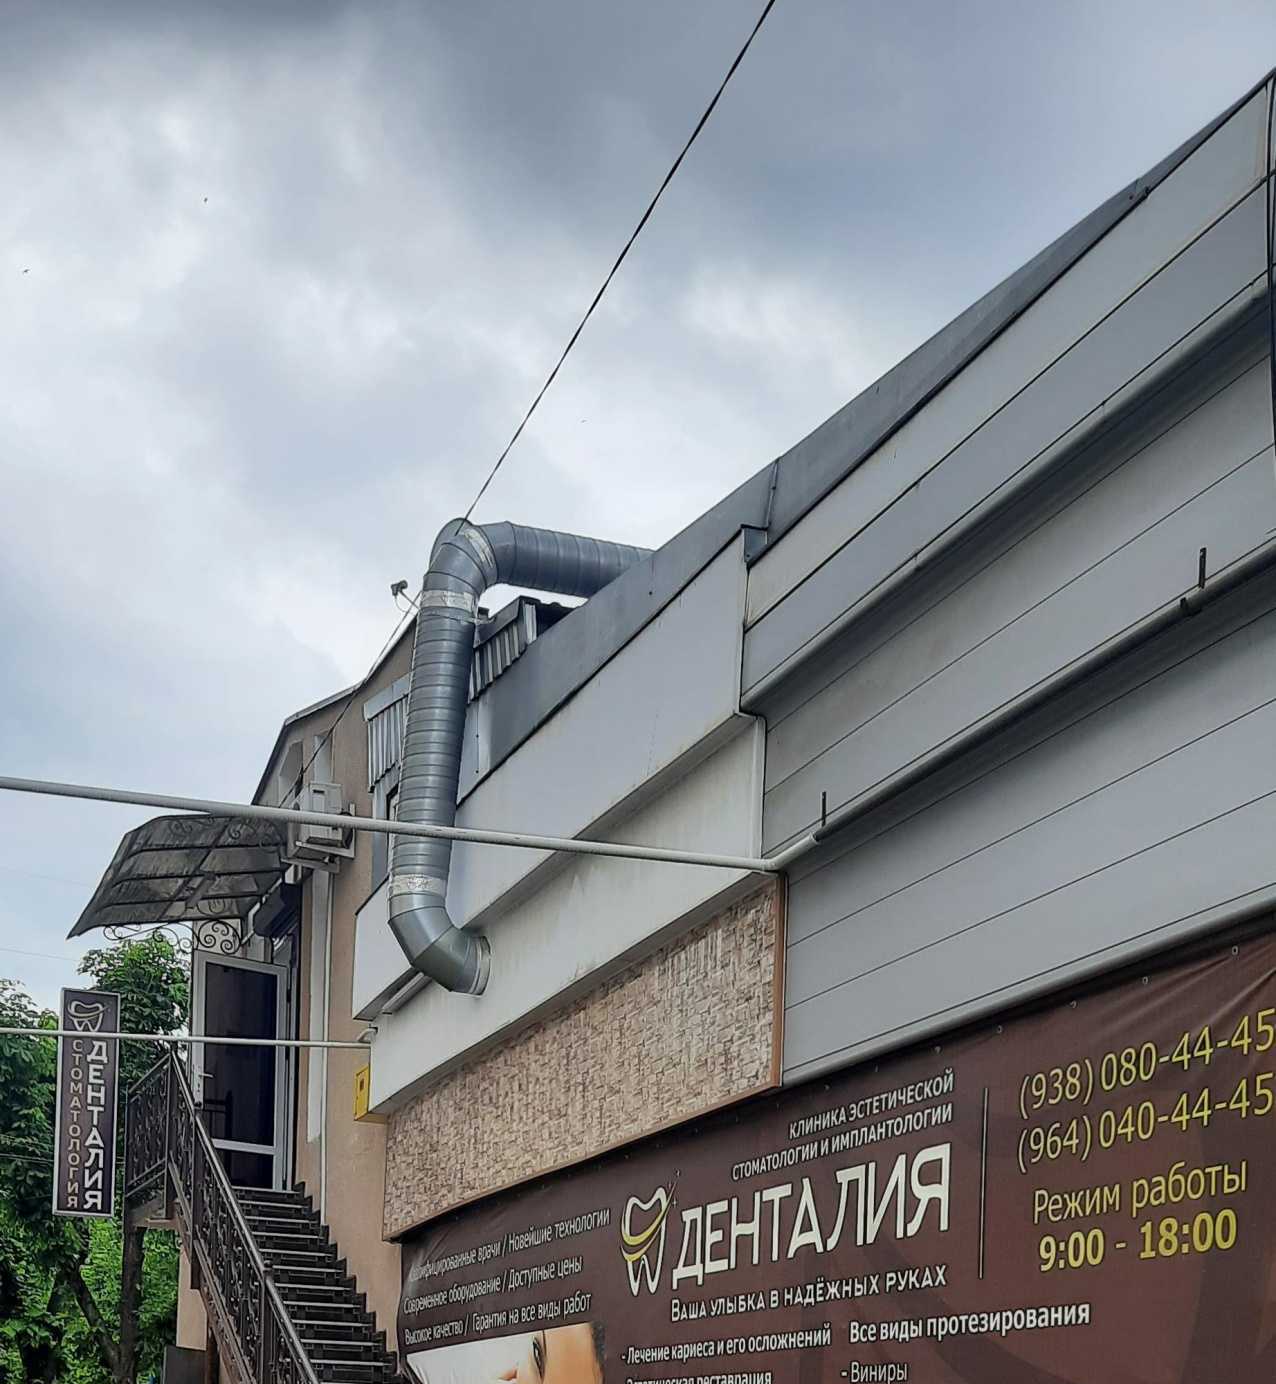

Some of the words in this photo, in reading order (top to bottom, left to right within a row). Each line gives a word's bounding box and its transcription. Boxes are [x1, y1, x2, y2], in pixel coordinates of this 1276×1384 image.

[1020, 1059, 1093, 1119] (938)
[1101, 1008, 1276, 1090] 080-44-45
[67, 1039, 83, 1208] СТОМАТОЛОГИЯ
[83, 1040, 108, 1210] ДЕНТАЛИЯ
[790, 1106, 847, 1140] КЛИНИКА
[849, 1069, 954, 1122] ЭСТЕТИЧЕСКОЙ
[1018, 1115, 1092, 1173] (964)
[1099, 1073, 1275, 1148] 040-44-45
[732, 1143, 818, 1181] СТОМАТОЛОГИИ
[820, 1138, 830, 1157] И
[831, 1103, 953, 1153] ИМПЛАНТОЛОГИИ
[672, 1143, 951, 1290] ДЕНТАЛИЯ
[1034, 1183, 1120, 1224] Режим
[1132, 1161, 1247, 1217] работы
[478, 1241, 501, 1264] врачи
[509, 1225, 552, 1253] Новейшие
[555, 1208, 610, 1238] технологии
[1039, 1228, 1105, 1271] 9:00
[1139, 1208, 1237, 1259] 18:00
[404, 1289, 447, 1316] Современное
[449, 1275, 500, 1305] оборудование
[508, 1264, 555, 1290] Доступные
[557, 1255, 583, 1278] цены
[405, 1328, 432, 1346] Высокое
[433, 1319, 463, 1338] качество
[472, 1312, 507, 1335] Гарантия
[509, 1308, 519, 1323] на
[521, 1304, 536, 1322] все
[538, 1300, 561, 1320] виды
[563, 1291, 592, 1320] работ
[627, 1346, 670, 1364] Лечение
[671, 1341, 715, 1363] кариеса
[717, 1341, 724, 1354] и
[727, 1339, 746, 1356] его
[748, 1323, 831, 1353] осложнений
[850, 1321, 877, 1344] Все
[880, 1318, 923, 1342] виды
[926, 1303, 1090, 1341] протезирования
